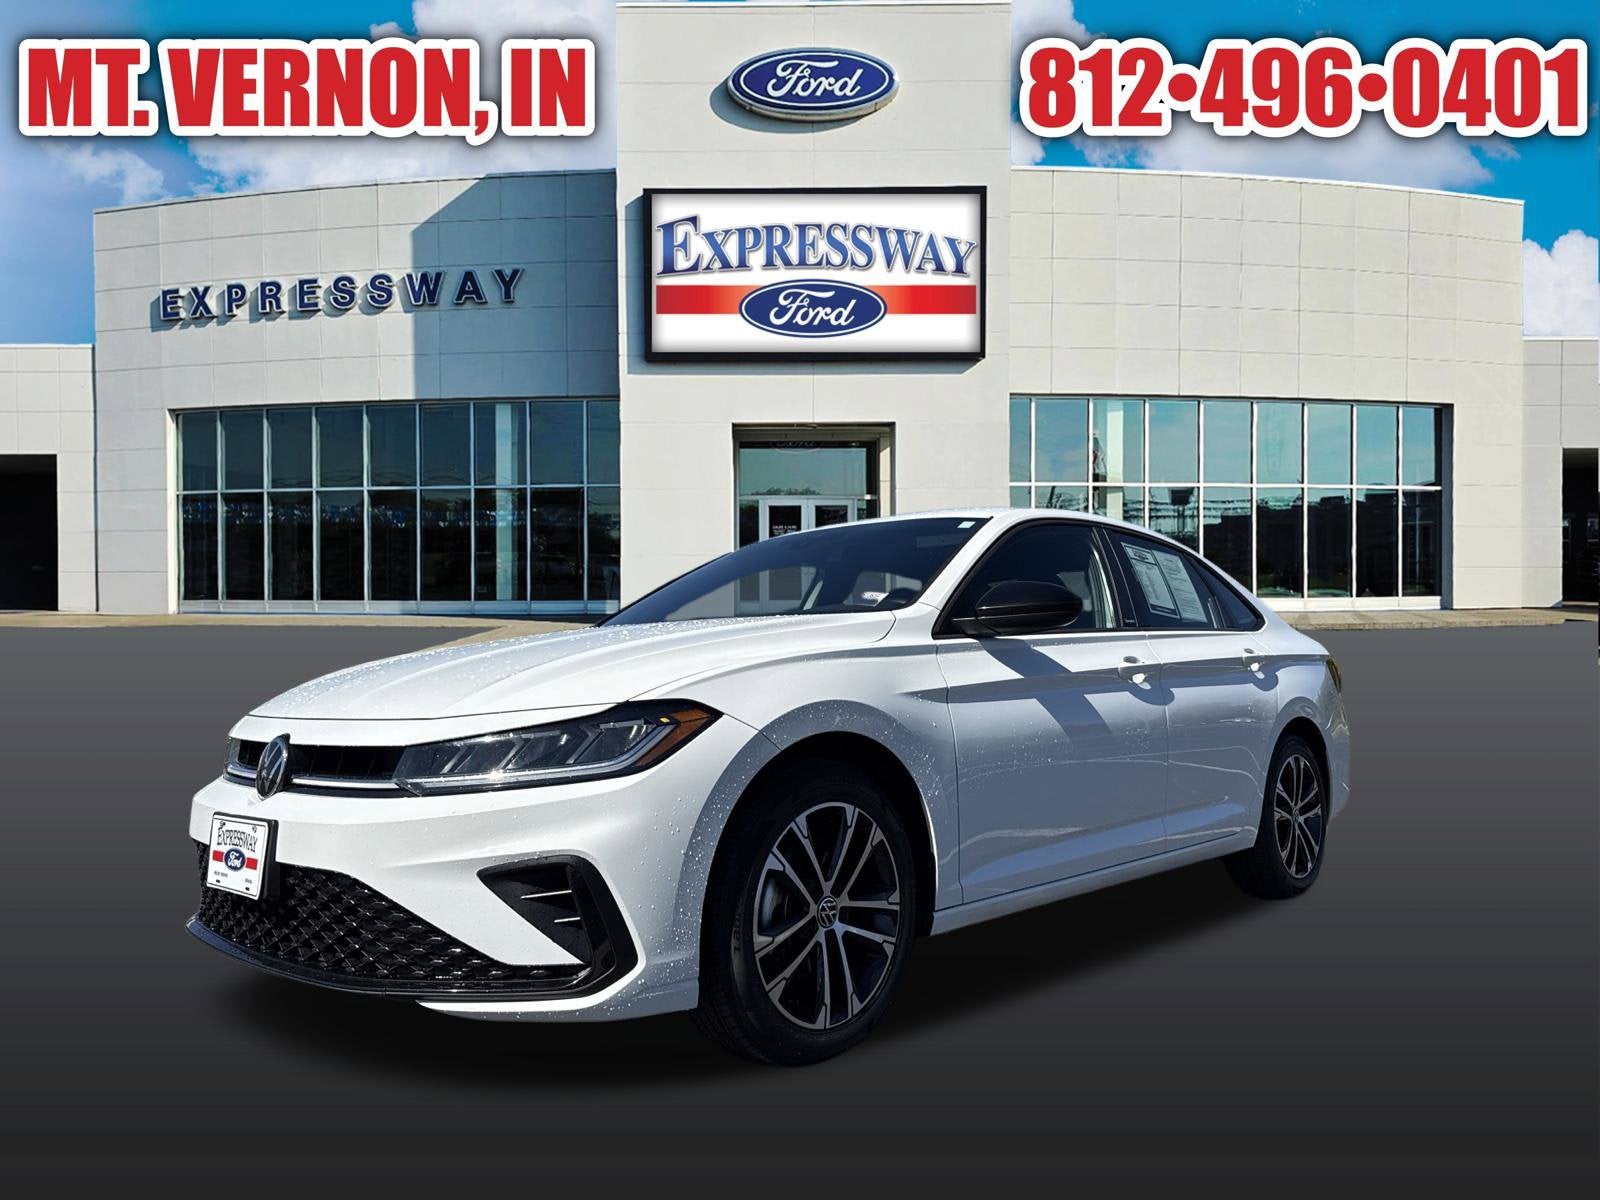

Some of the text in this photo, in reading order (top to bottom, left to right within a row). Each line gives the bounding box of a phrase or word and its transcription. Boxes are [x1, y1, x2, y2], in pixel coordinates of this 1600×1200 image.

[766, 59, 864, 98] Ford
[655, 214, 977, 278] EXPRESSWAY
[160, 267, 525, 322] EXPRESSWAY
[769, 288, 857, 326] Ford
